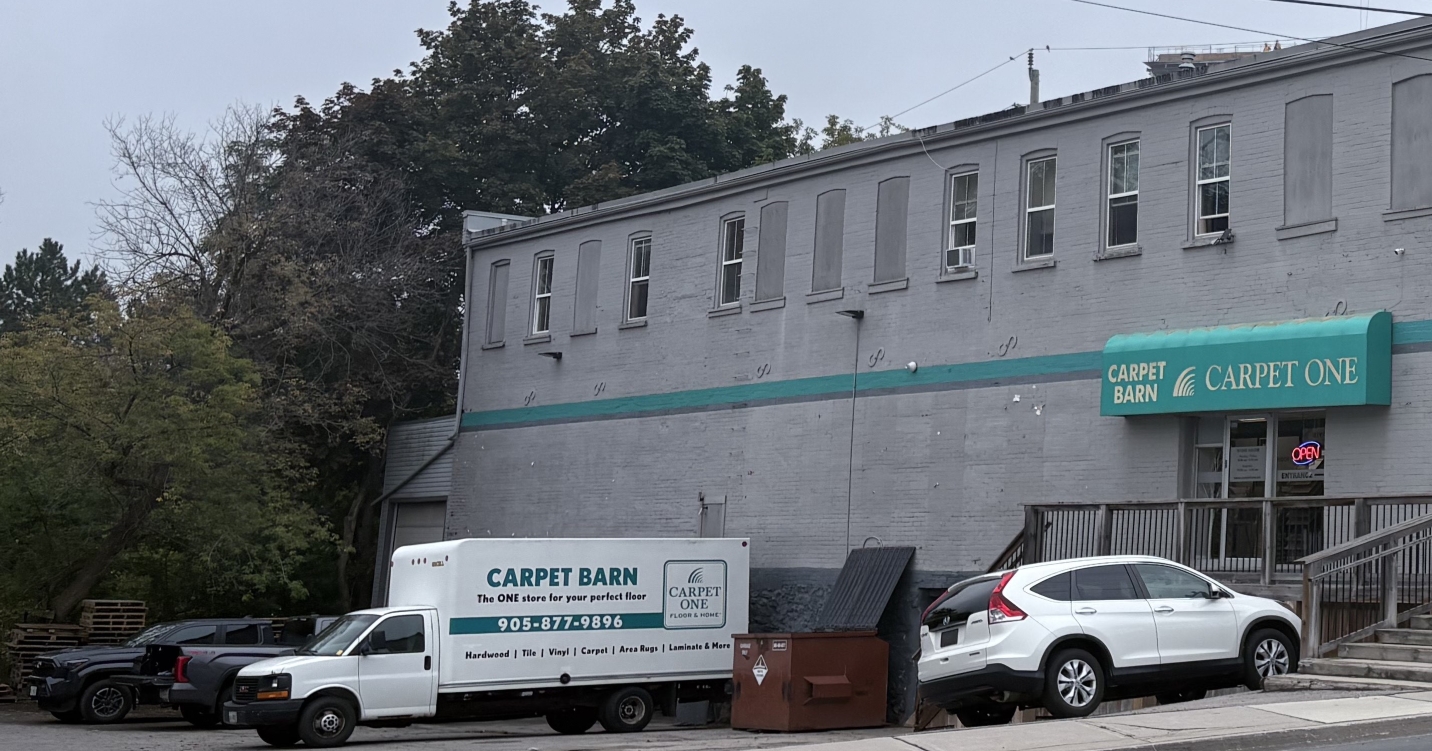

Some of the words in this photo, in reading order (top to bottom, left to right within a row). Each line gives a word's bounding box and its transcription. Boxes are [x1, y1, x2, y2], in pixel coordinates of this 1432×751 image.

[1108, 361, 1167, 383] CARPET
[1205, 360, 1298, 391] CARPET
[1304, 357, 1359, 386] ONE
[1114, 383, 1158, 404] BARN
[1292, 446, 1320, 461] OPEN
[487, 567, 573, 588] CARPET
[578, 567, 638, 587] BARN
[477, 594, 494, 603] The
[498, 593, 519, 603] ONE
[522, 594, 546, 602] store
[549, 593, 563, 602] for
[566, 594, 588, 603] your
[590, 592, 623, 603] perfect
[625, 591, 647, 601] floor
[669, 586, 721, 598] CARPET
[680, 599, 709, 610] ONE
[498, 615, 623, 632] 905-877-9896
[465, 650, 510, 659] Hardwood
[522, 649, 536, 657] Tile
[548, 647, 569, 657] Vinyl
[581, 646, 608, 655] Carpet
[619, 645, 638, 653] Area
[640, 644, 658, 653] Rugs
[669, 643, 703, 651] Laminate
[712, 641, 730, 649] More
